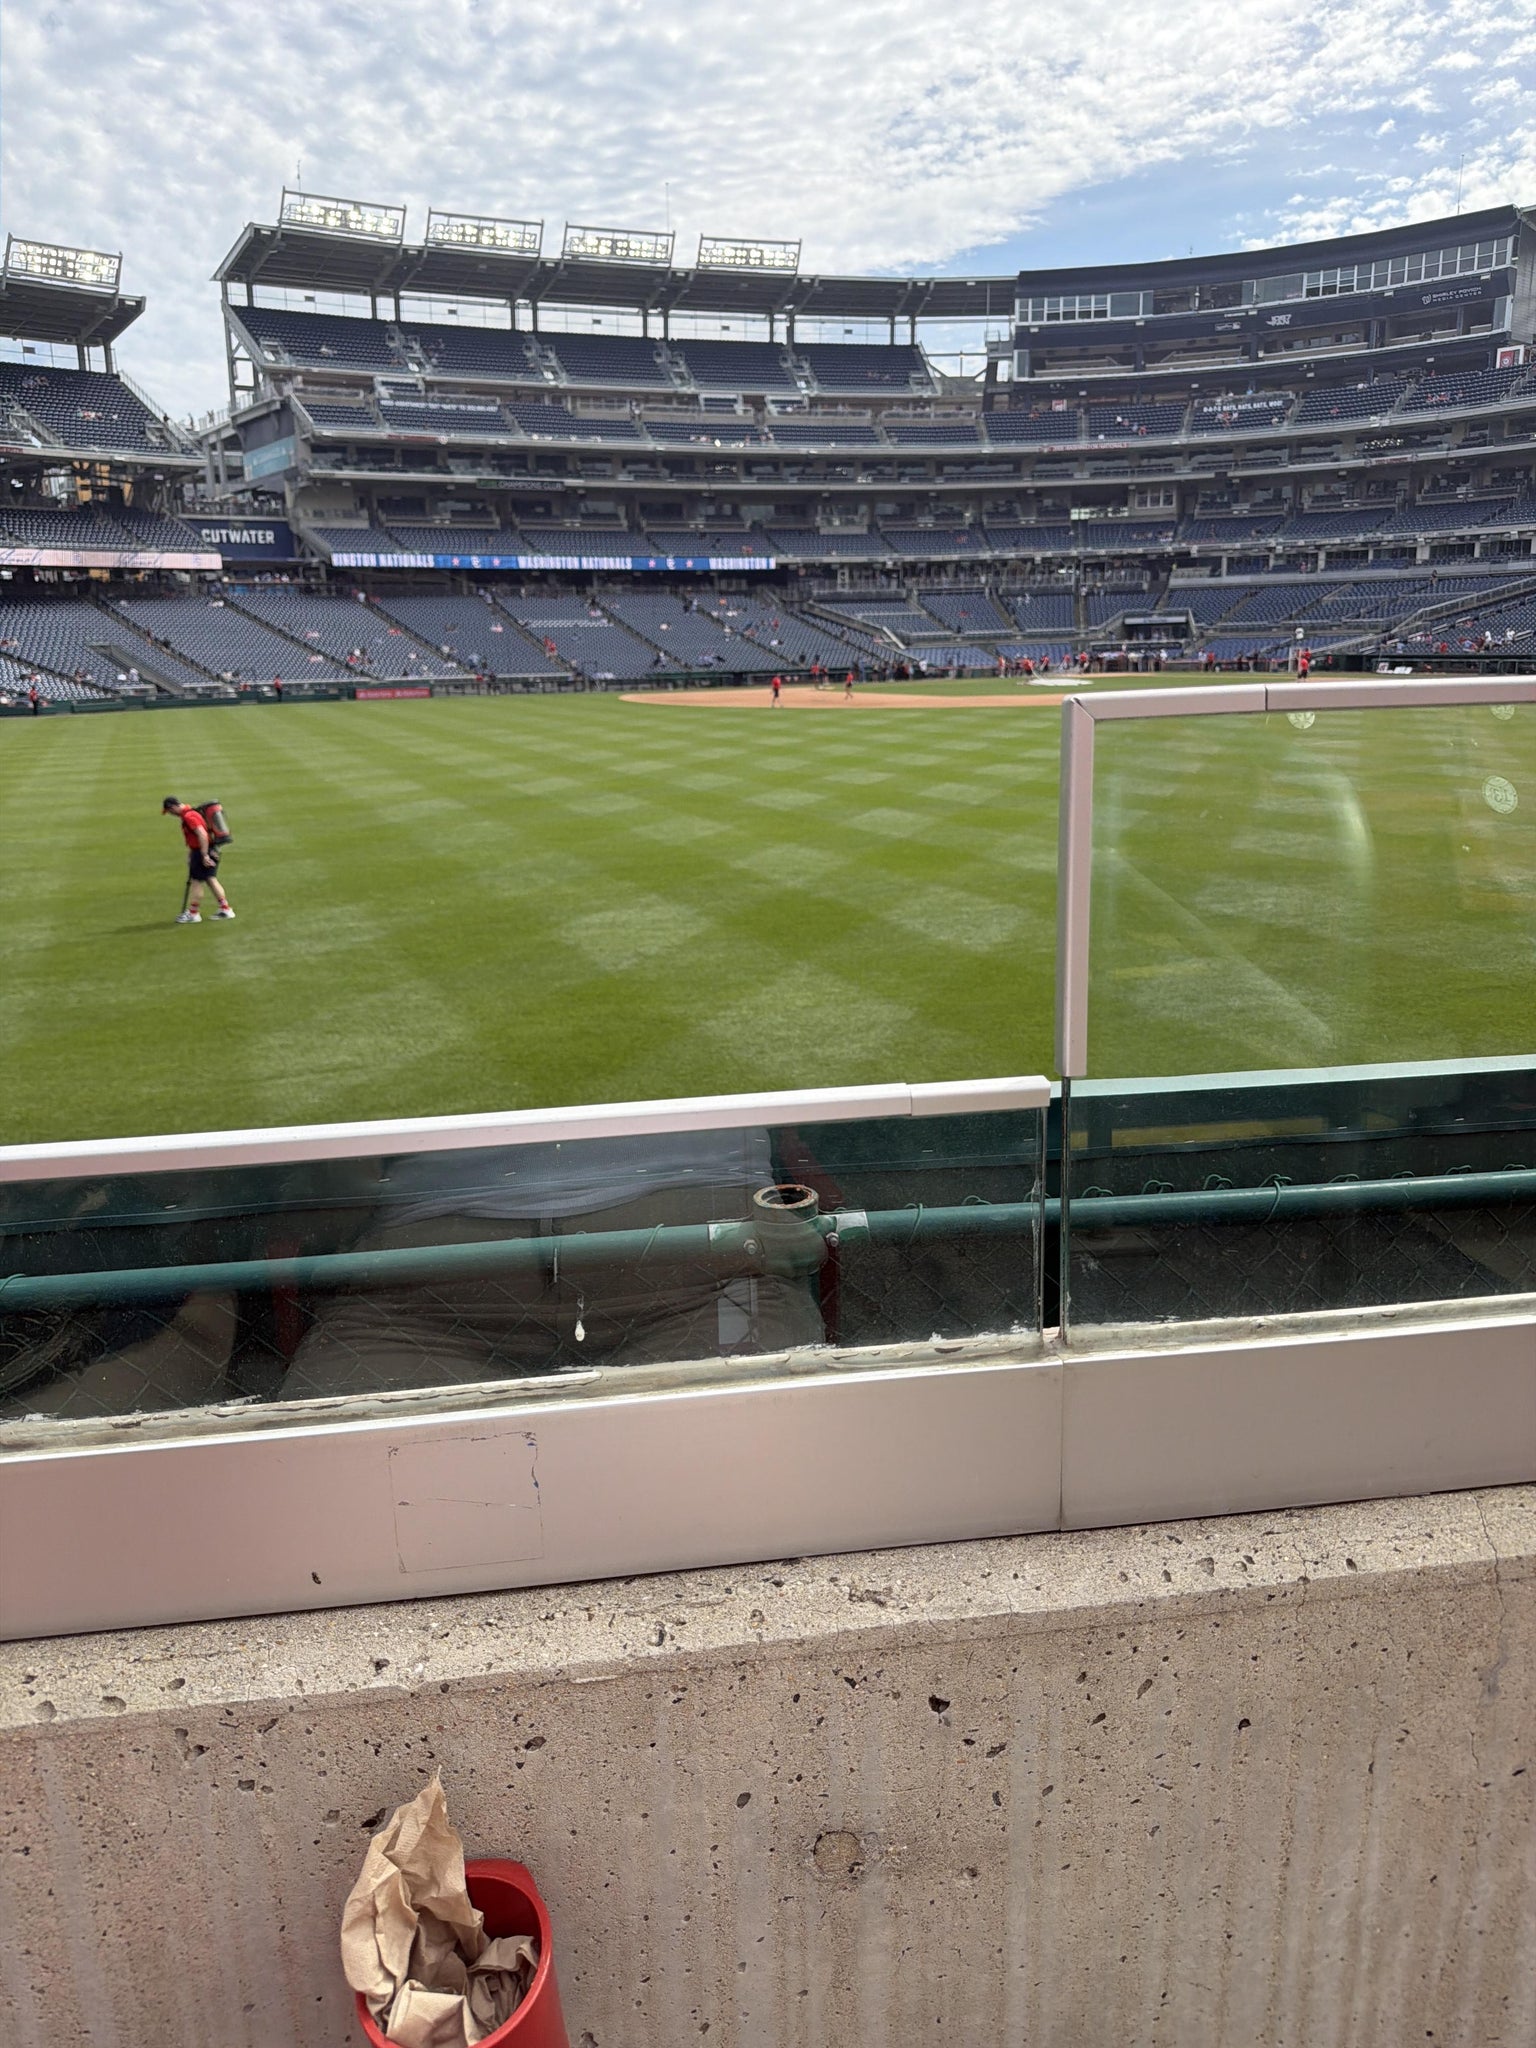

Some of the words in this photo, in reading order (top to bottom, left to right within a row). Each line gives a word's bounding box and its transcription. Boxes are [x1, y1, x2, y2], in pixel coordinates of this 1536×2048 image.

[1459, 287, 1482, 295] POVICH
[201, 528, 275, 545] CUTWATER
[378, 553, 435, 568] NATIONALS
[517, 555, 580, 570] WASHINGTON
[581, 556, 632, 570] NATIONALS
[709, 557, 767, 570] WASHINGTON
